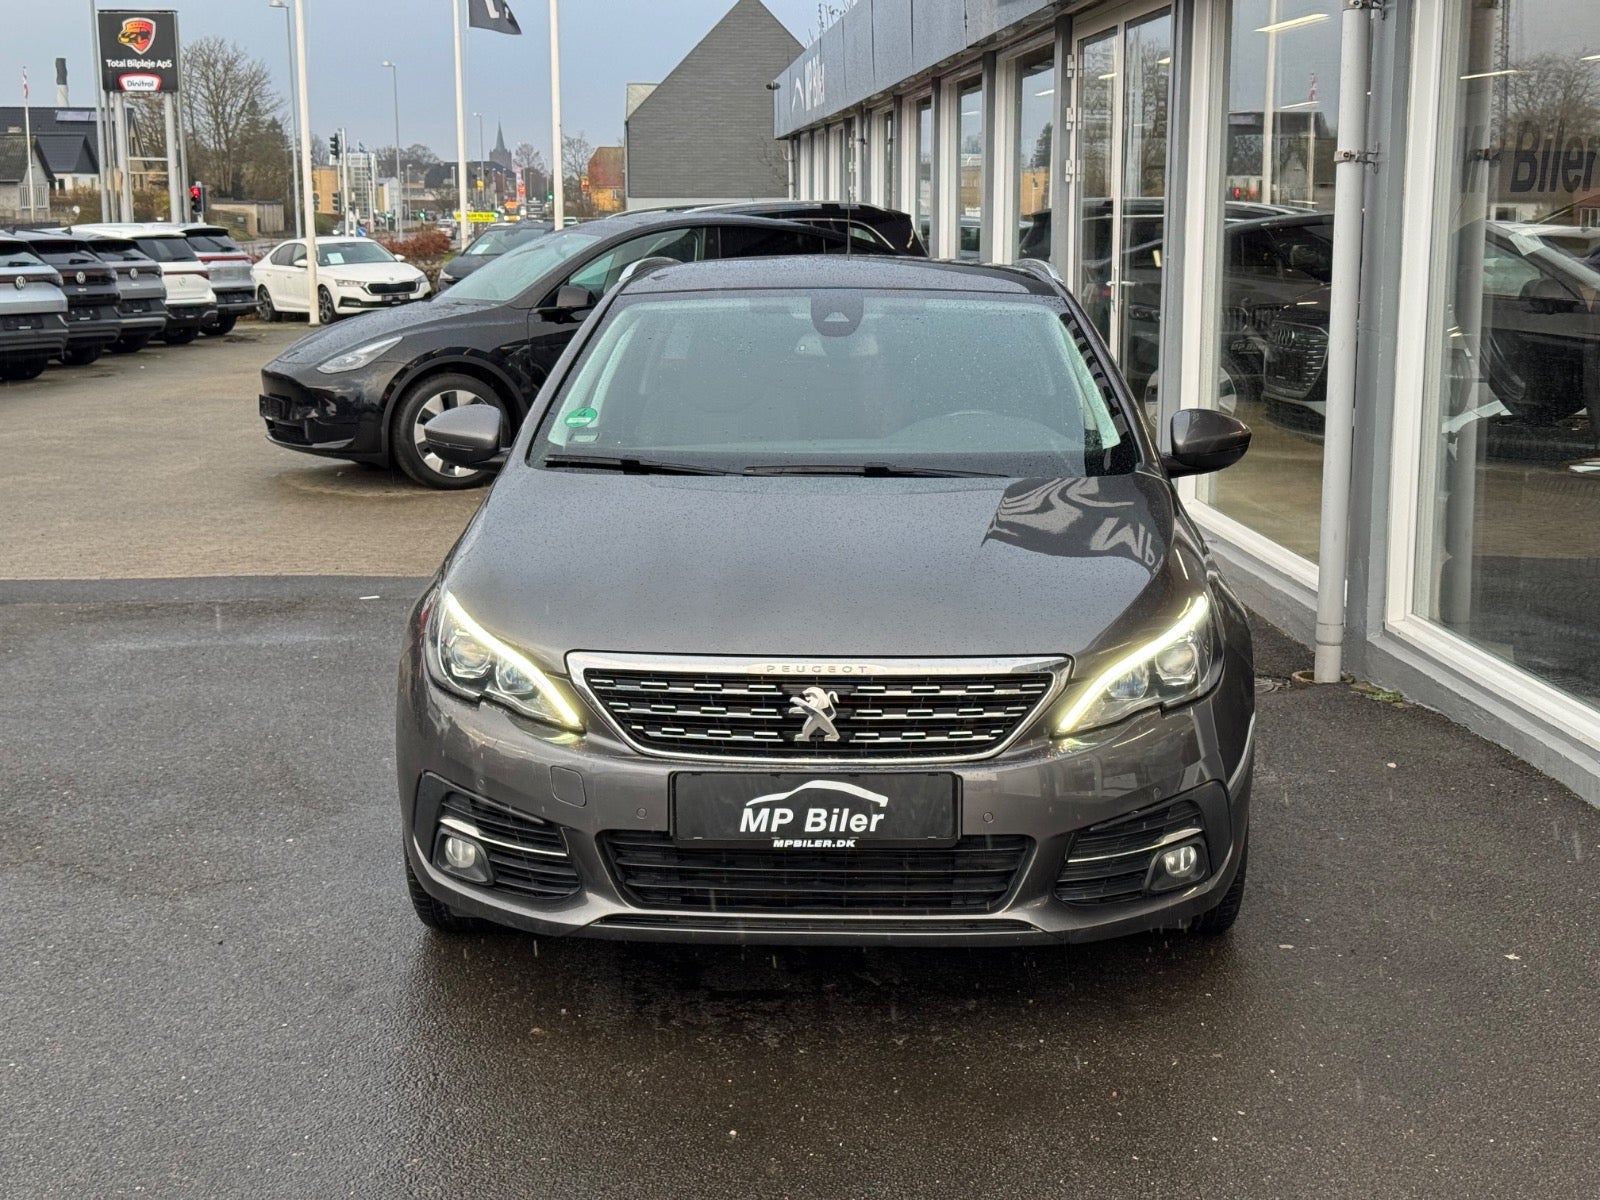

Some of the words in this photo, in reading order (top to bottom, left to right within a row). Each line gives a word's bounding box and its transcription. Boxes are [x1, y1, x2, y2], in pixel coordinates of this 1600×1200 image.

[106, 58, 126, 68] Total
[127, 58, 156, 69] Bilpleje
[157, 59, 172, 69] ApS
[1510, 119, 1597, 193] Biler
[766, 665, 868, 674] PEUGEOT
[739, 808, 794, 833] MP
[804, 808, 885, 833] Biler
[773, 839, 856, 848] MPBILER.DK
